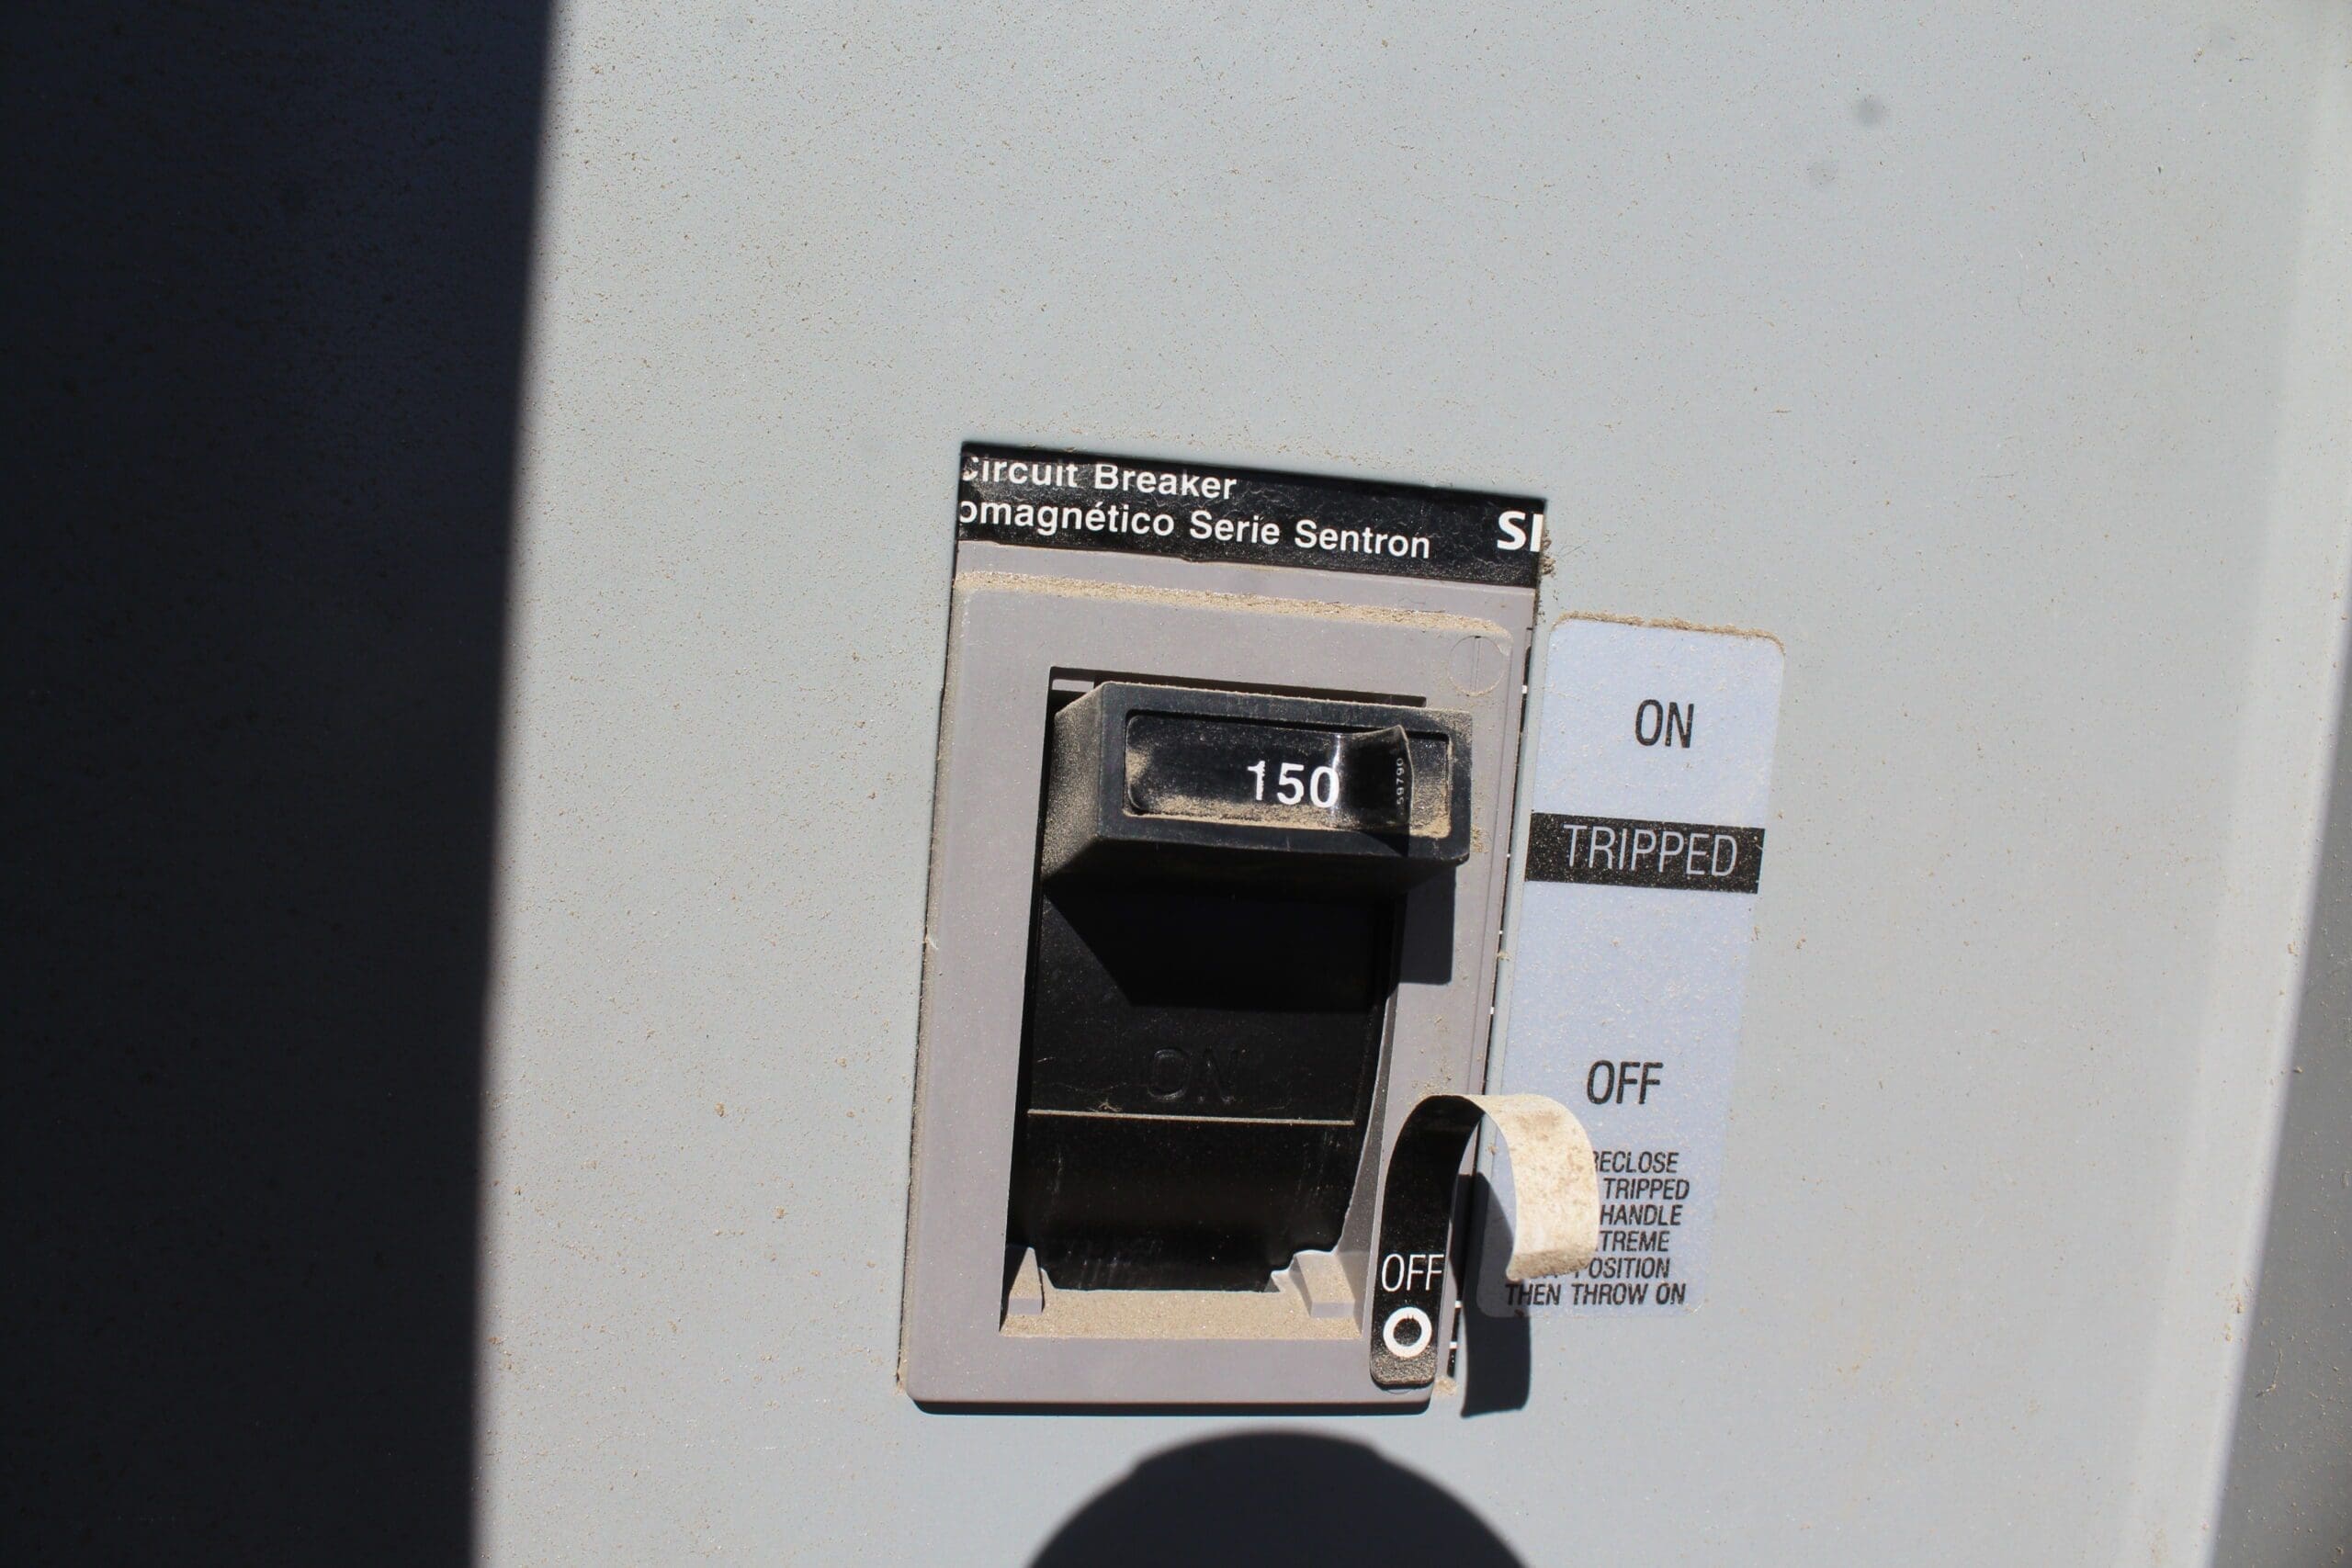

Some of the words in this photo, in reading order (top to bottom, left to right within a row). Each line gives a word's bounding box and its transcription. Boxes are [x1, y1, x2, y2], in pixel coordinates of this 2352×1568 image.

[1094, 462, 1238, 500] Breaker
[959, 500, 1175, 536] omagnético
[1189, 510, 1281, 546] Serie
[1294, 518, 1430, 559] Sentron
[1634, 698, 1695, 749] ON
[1247, 759, 1340, 808] 150
[1563, 823, 1738, 877] TRIPPED
[1148, 1047, 1238, 1103] ON
[1587, 1059, 1665, 1105] OFF
[1603, 1178, 1690, 1201] TRIPPED
[1600, 1203, 1683, 1226] HANDLE
[1595, 1229, 1670, 1252] TREME
[1381, 1253, 1445, 1292] OFF
[1505, 1283, 1561, 1306] THEN
[1571, 1282, 1648, 1306] THROW
[1655, 1282, 1687, 1306] ON
